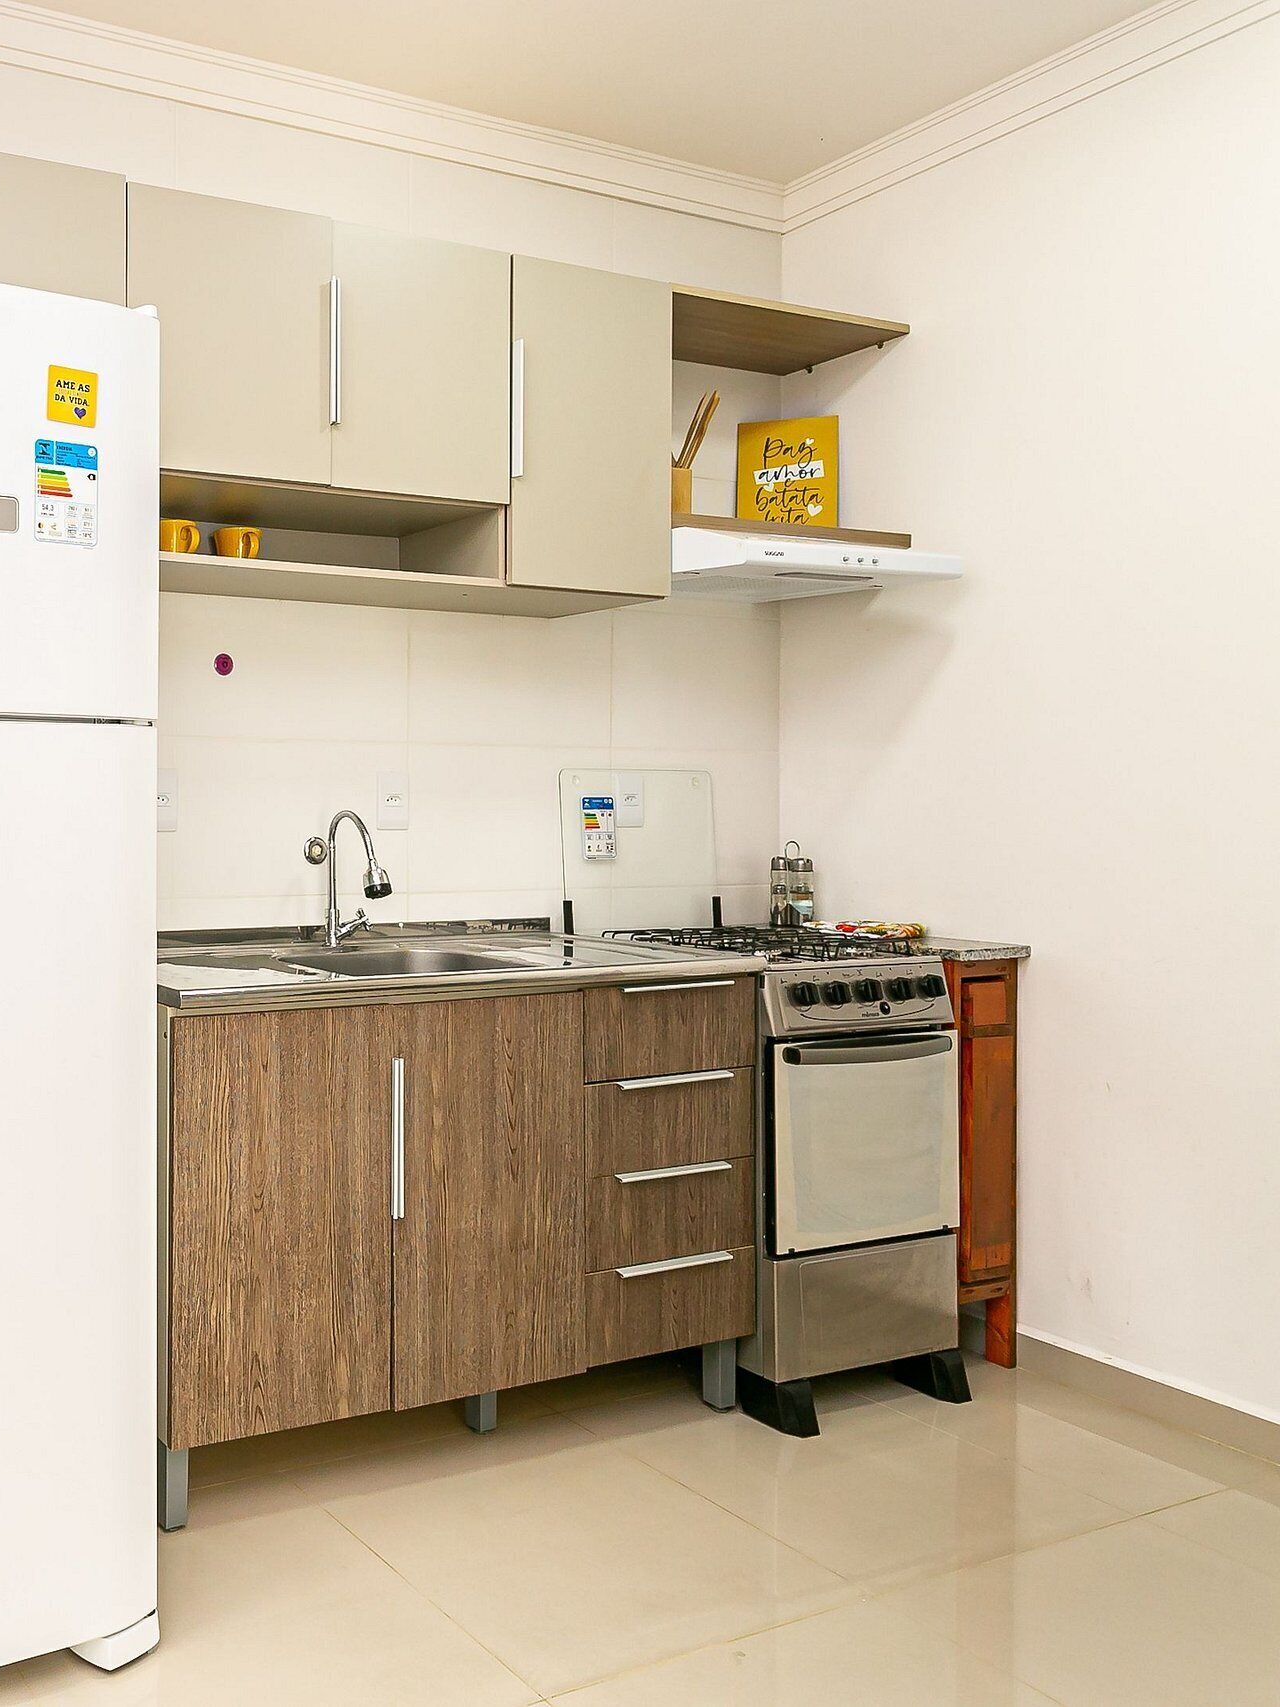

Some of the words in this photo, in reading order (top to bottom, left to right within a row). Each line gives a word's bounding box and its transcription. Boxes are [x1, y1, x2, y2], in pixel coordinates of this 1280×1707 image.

[56, 379, 76, 391] AME
[77, 383, 91, 393] AS
[54, 393, 66, 402] DA
[758, 464, 821, 482] amor
[755, 486, 825, 512] batata
